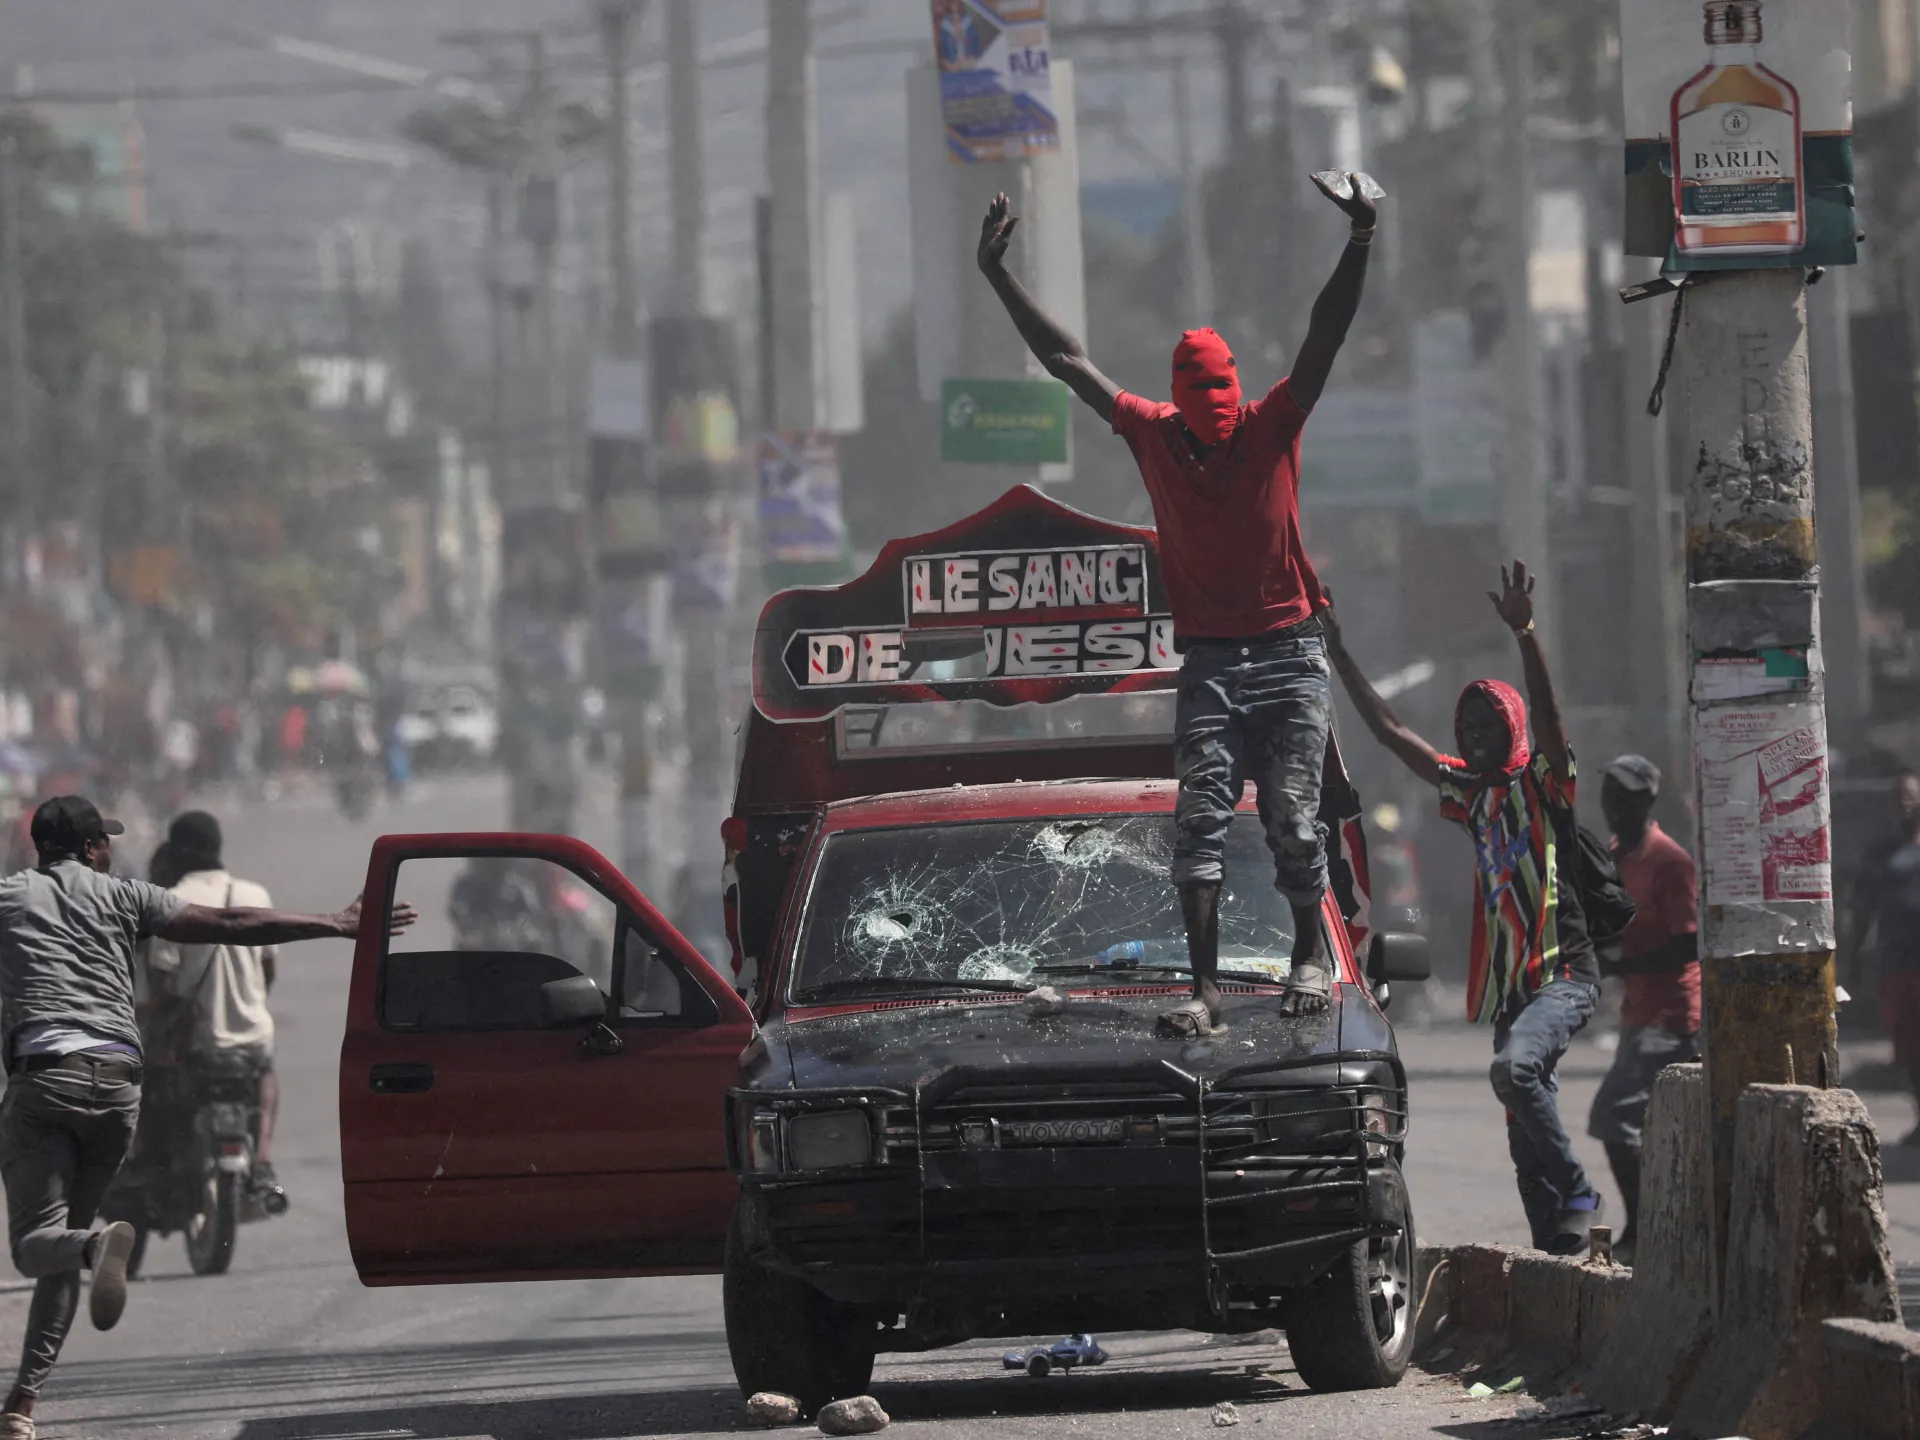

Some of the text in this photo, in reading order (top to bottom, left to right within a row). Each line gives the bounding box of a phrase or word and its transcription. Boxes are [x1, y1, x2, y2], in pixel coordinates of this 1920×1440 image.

[1694, 150, 1780, 168] BARLIN
[1723, 169, 1753, 177] RHUM
[911, 549, 1144, 614] LE SANG
[808, 631, 900, 684] DE
[1014, 1120, 1124, 1142] TOYOTA
